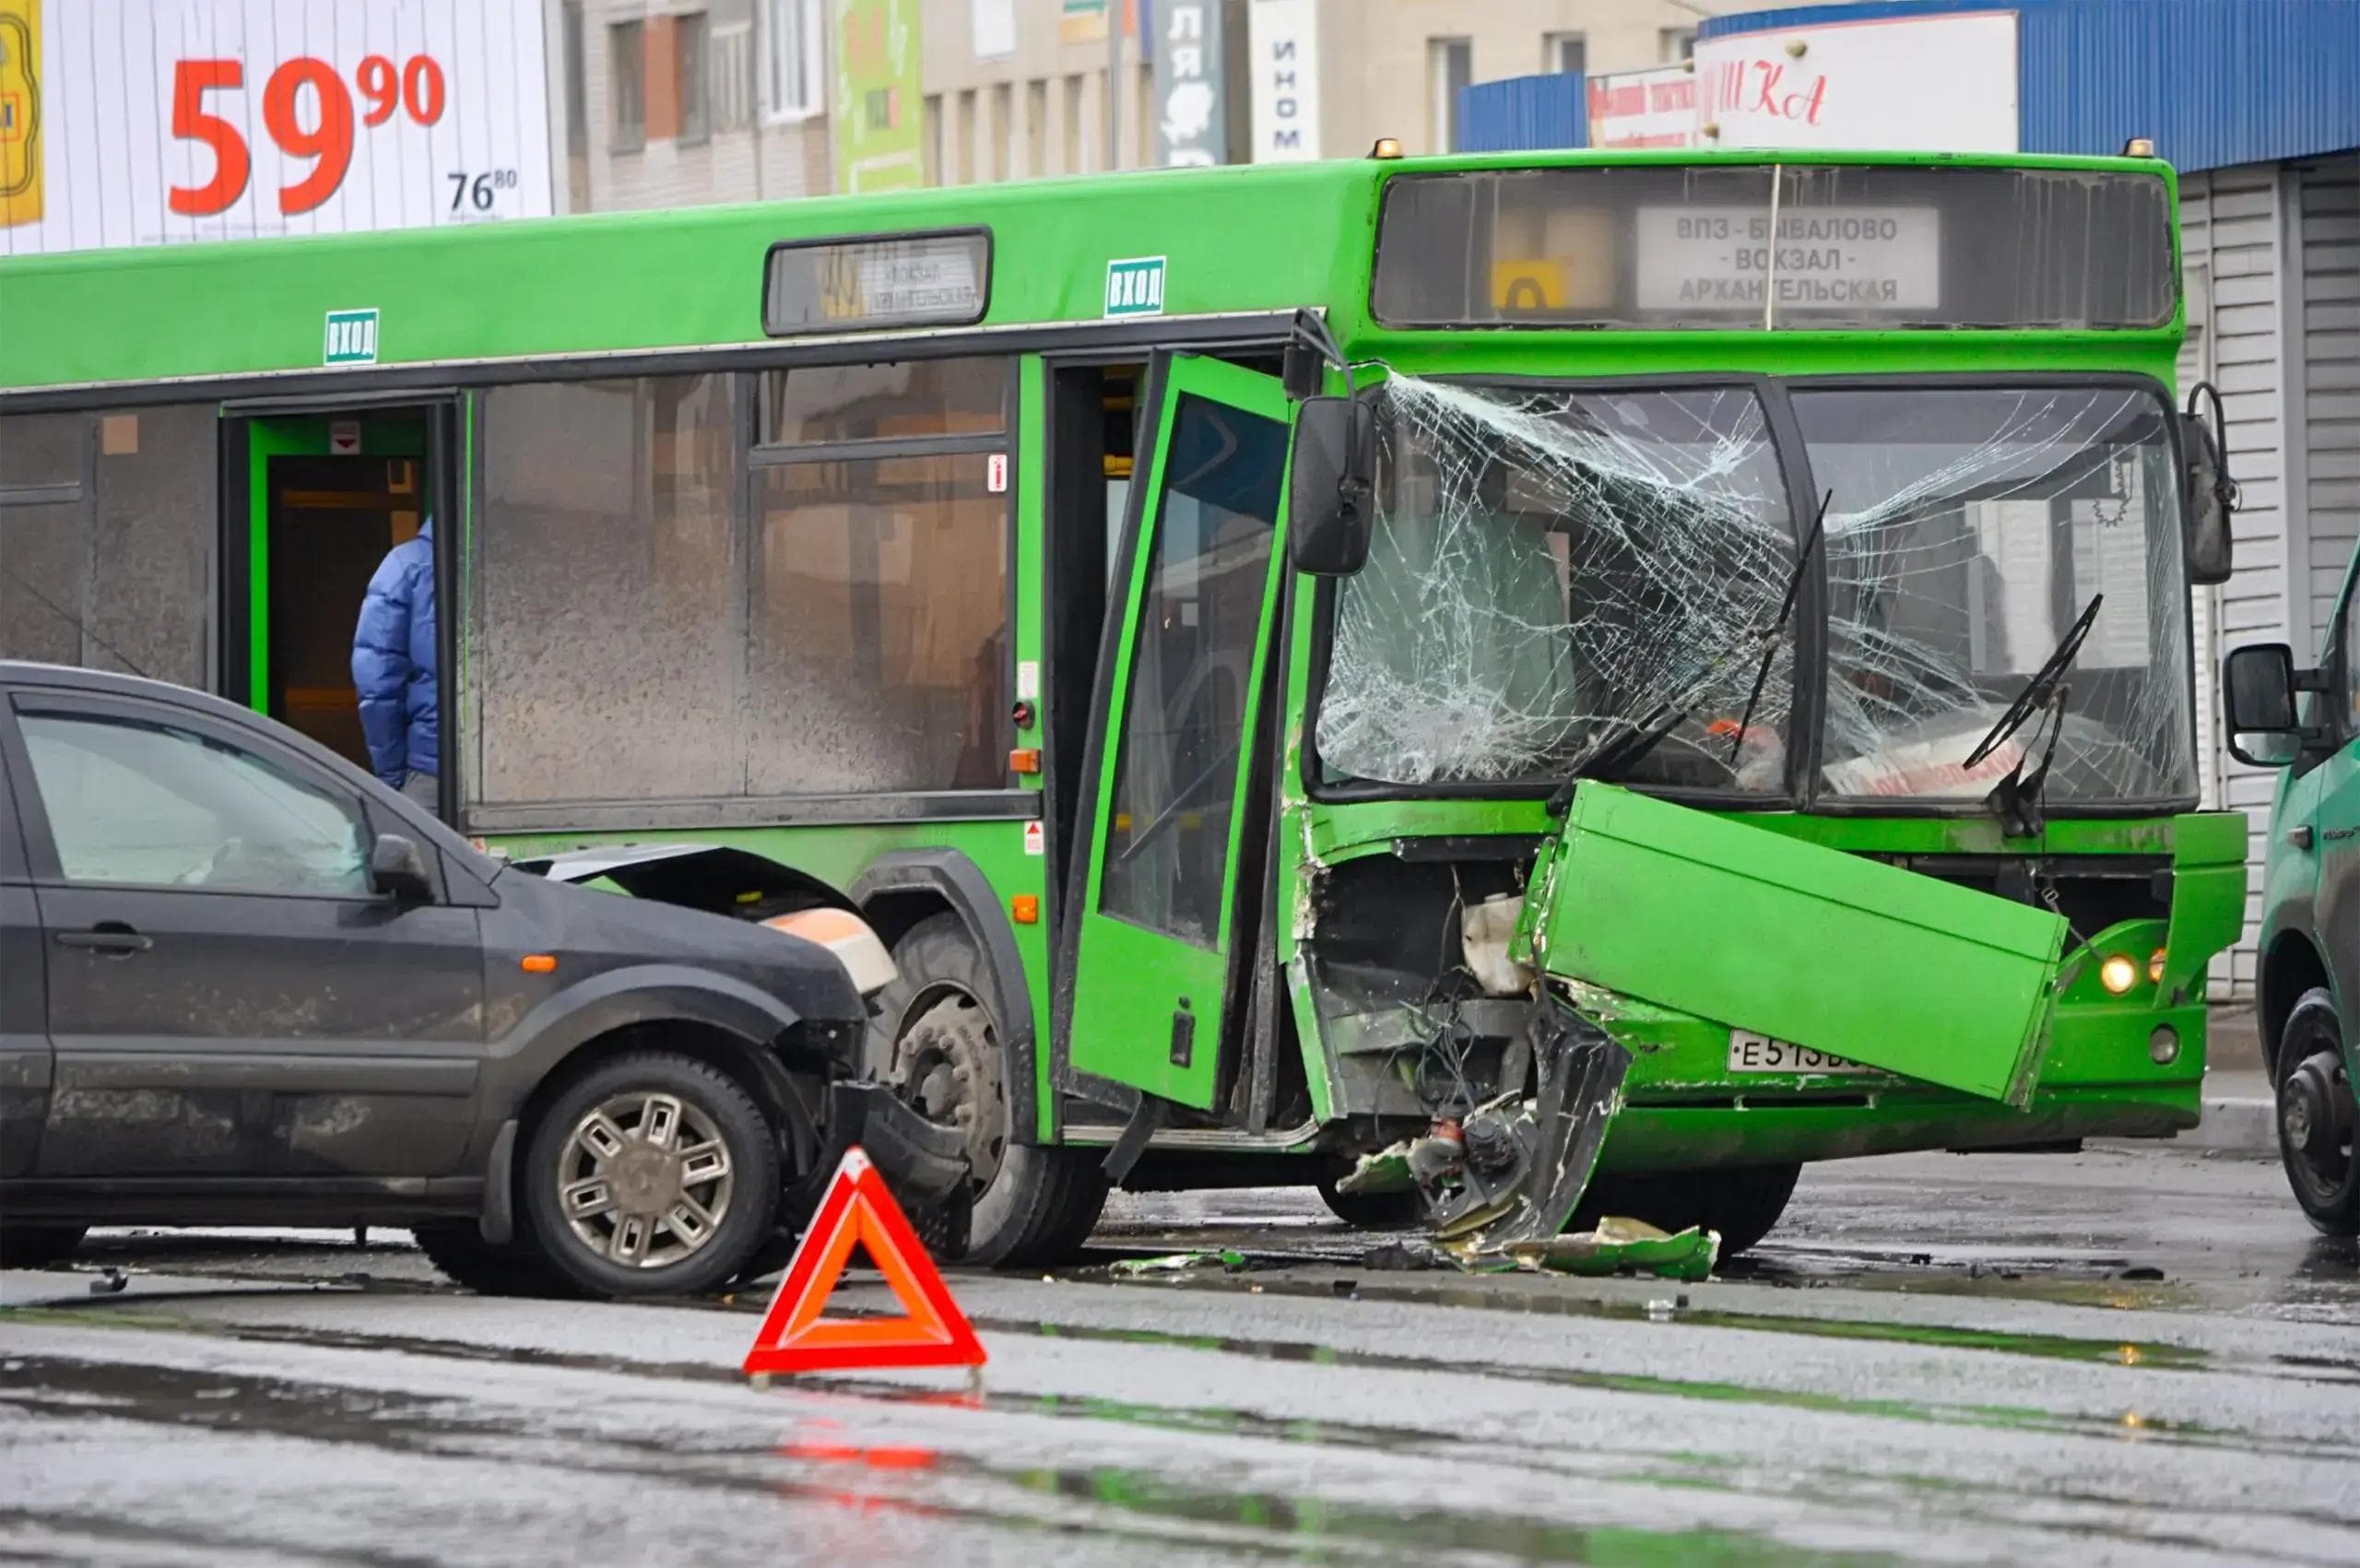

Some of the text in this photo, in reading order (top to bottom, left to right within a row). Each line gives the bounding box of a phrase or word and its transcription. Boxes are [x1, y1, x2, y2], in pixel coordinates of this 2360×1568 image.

[1735, 248, 1841, 270] ВОКЗАЛ
[1109, 268, 1162, 307] ВХОД
[1678, 278, 1898, 301] АРХАНЕЛЬСКАЯ
[328, 320, 375, 356] ВХОД
